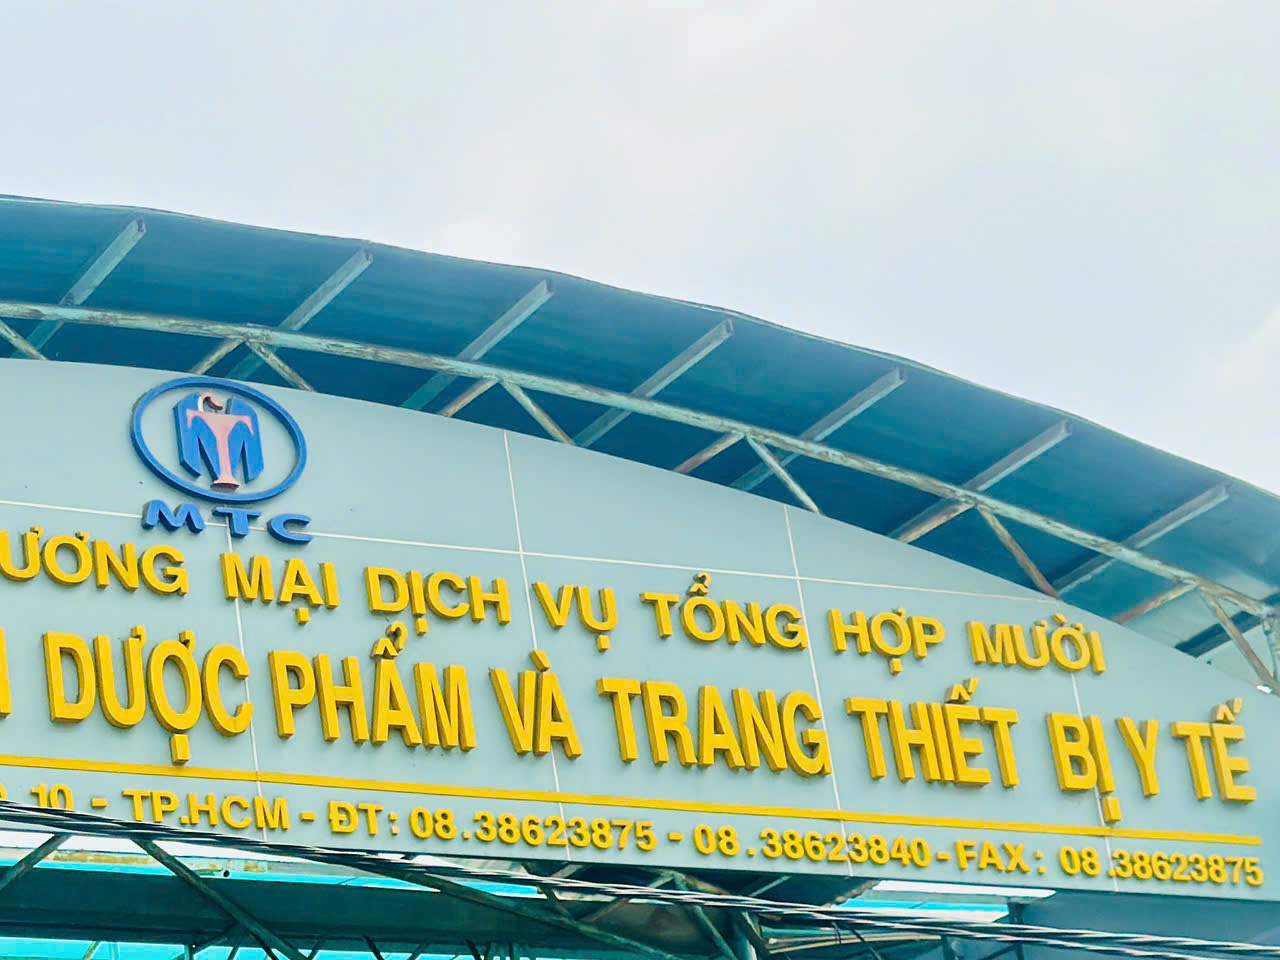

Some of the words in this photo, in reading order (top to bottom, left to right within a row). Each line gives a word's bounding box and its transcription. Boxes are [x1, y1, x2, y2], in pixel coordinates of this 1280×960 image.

[142, 499, 313, 544] MTC
[220, 553, 340, 625] MẠI
[365, 566, 512, 635] DỊCH
[533, 582, 618, 651] VỤ
[639, 573, 809, 652] TỔNG
[828, 608, 945, 675] HỢP
[967, 613, 1106, 674] MƯỜI
[42, 625, 254, 764] DƯỢC
[268, 620, 477, 752] PHẨM
[490, 650, 583, 759] VÀ
[596, 677, 833, 778] TRANG
[846, 678, 1019, 788] THIẾT
[1047, 712, 1122, 825] BỊ
[1117, 718, 1159, 798] Y
[1172, 697, 1258, 803] TẾ
[121, 789, 291, 830] TP.HCM
[327, 802, 398, 837] ĐT:
